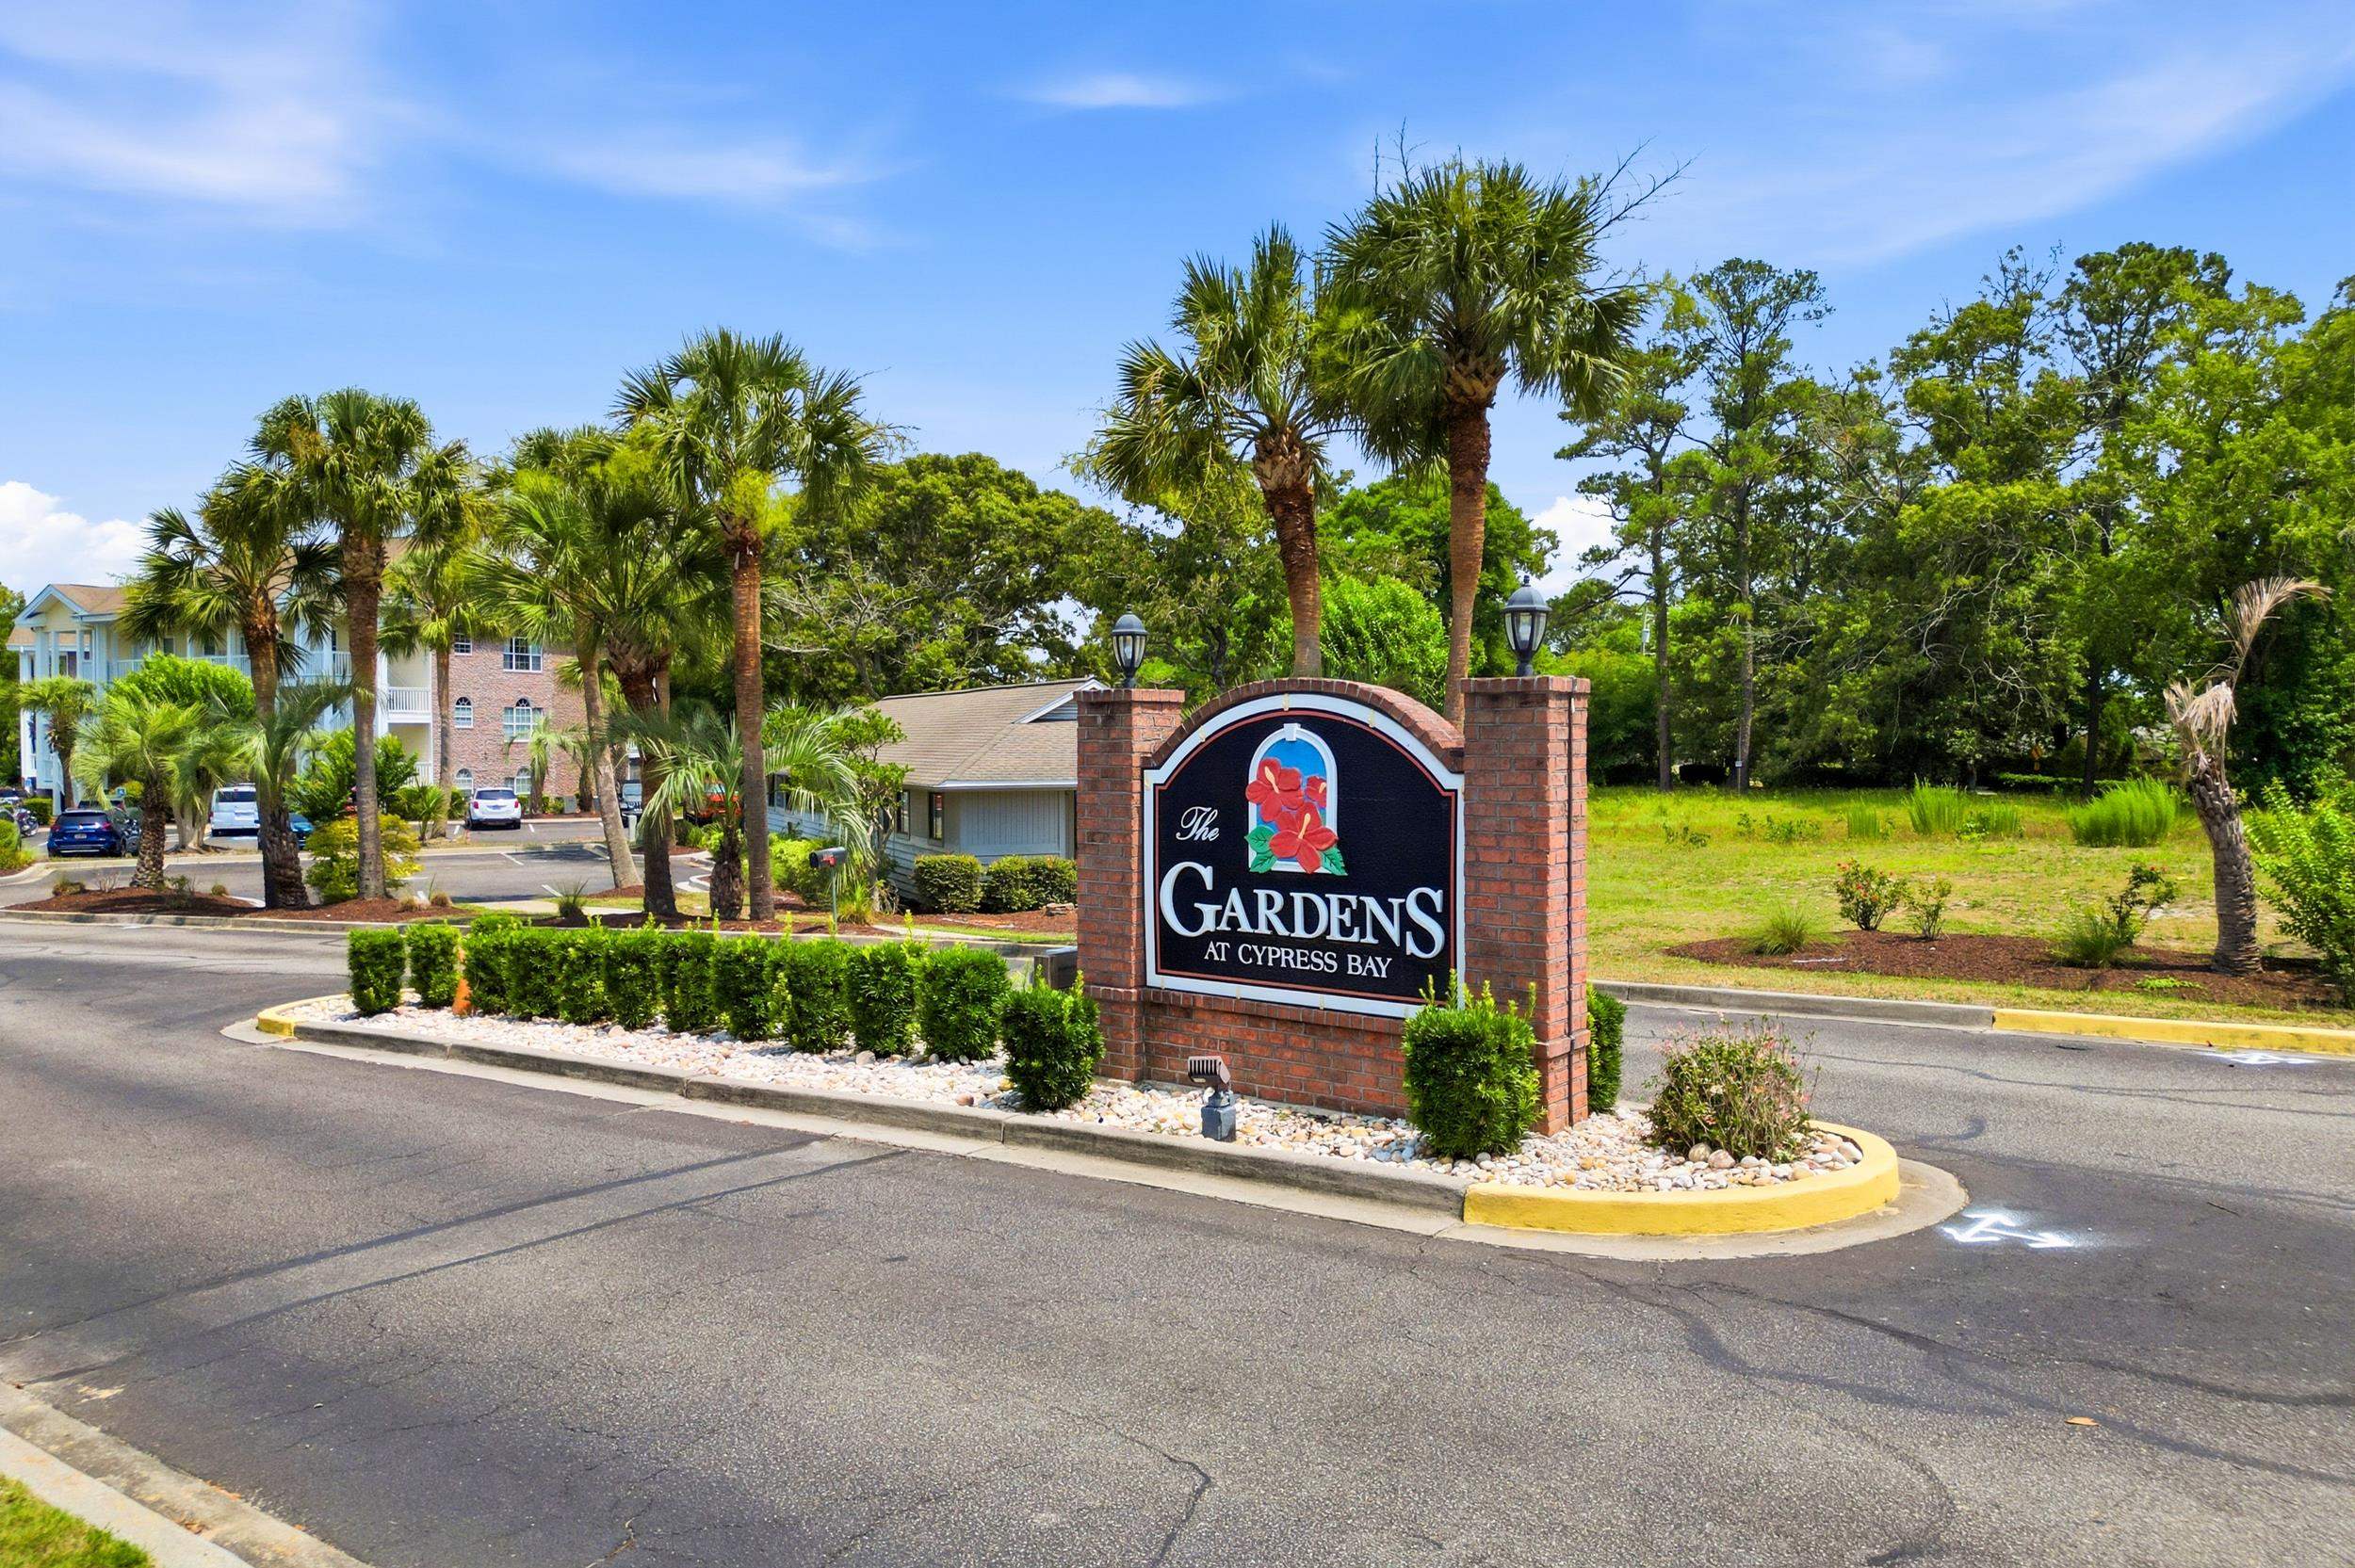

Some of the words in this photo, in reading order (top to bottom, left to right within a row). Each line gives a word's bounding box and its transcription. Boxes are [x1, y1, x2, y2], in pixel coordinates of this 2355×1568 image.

[1176, 806, 1220, 841] The
[1160, 862, 1445, 959] GARDENS
[1204, 941, 1231, 962] AT
[1238, 943, 1338, 974] CYPRESS
[1346, 954, 1392, 978] BAY
